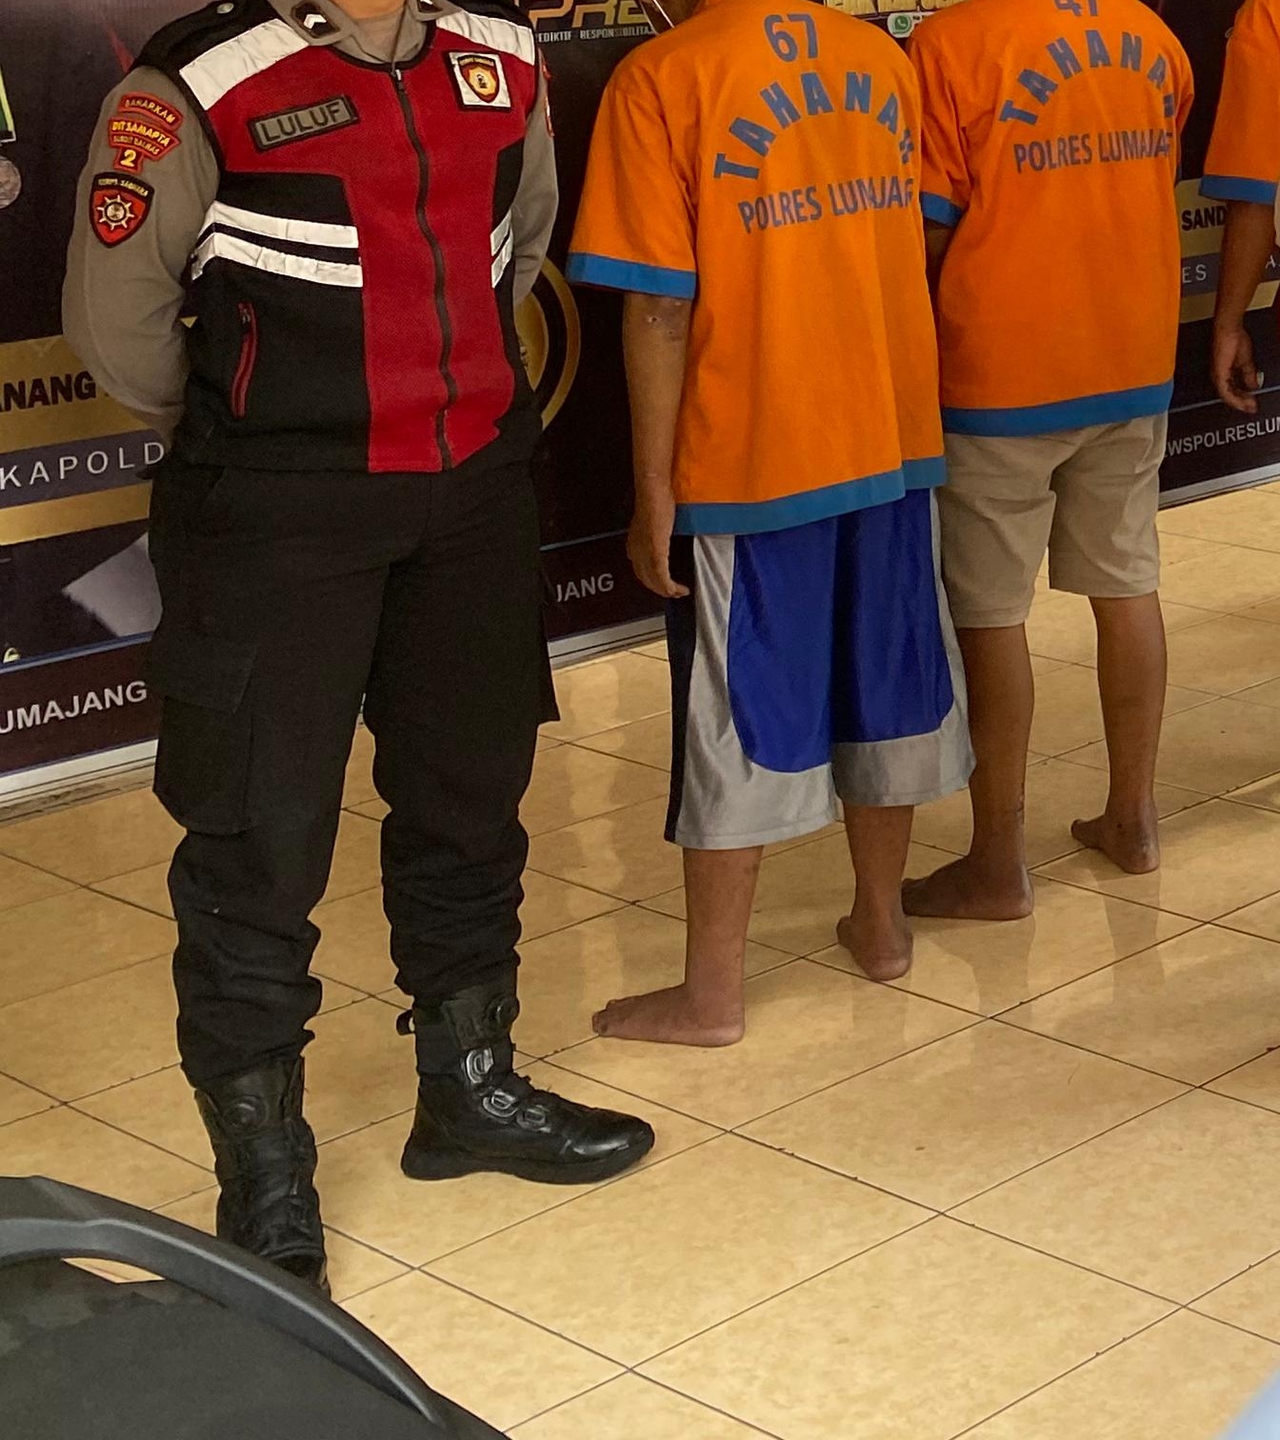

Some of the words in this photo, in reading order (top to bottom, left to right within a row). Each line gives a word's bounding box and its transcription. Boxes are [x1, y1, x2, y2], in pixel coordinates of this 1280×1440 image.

[536, 31, 571, 43] EDIKTIF
[580, 25, 653, 41] RESPONSIBILITA
[764, 13, 818, 62] 67
[127, 122, 170, 147] SAMAPTA
[259, 102, 343, 142] LULUF
[120, 149, 137, 167] 2
[1013, 133, 1092, 173] POLRES
[738, 185, 822, 234] POLRES
[1182, 205, 1226, 232] SAND
[1, 370, 96, 411] NANG
[0, 442, 165, 490] KAPOLD
[556, 573, 614, 602] JANG
[0, 680, 147, 734] UMAJANG
